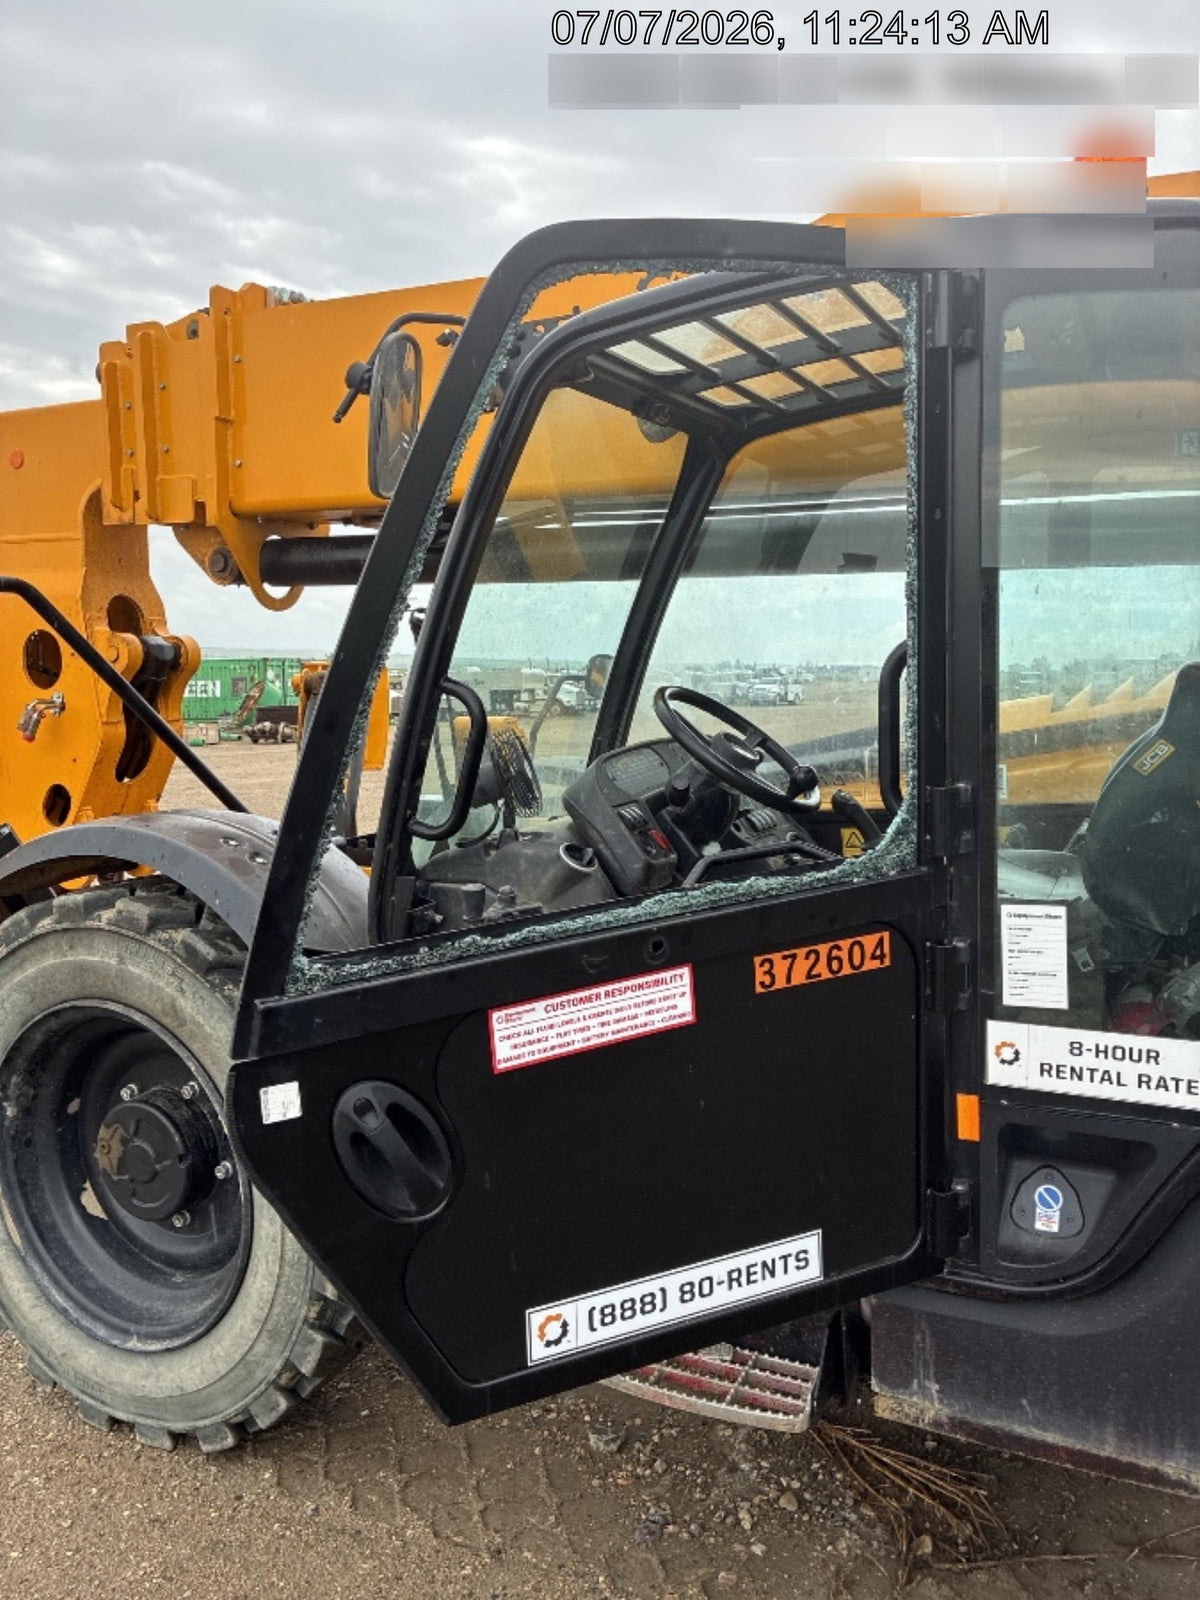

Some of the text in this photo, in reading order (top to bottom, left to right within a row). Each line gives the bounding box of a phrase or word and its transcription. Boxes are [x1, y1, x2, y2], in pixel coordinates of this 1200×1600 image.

[1142, 744, 1169, 771] JCB
[758, 935, 888, 990] 372604
[543, 972, 684, 1014] CUSTOMER RESPONSIBILITY
[1069, 1040, 1161, 1066] 8-HOUR
[1039, 1061, 1200, 1096] RENTAL RATE
[587, 1249, 811, 1332] (888) 80-RENTS
